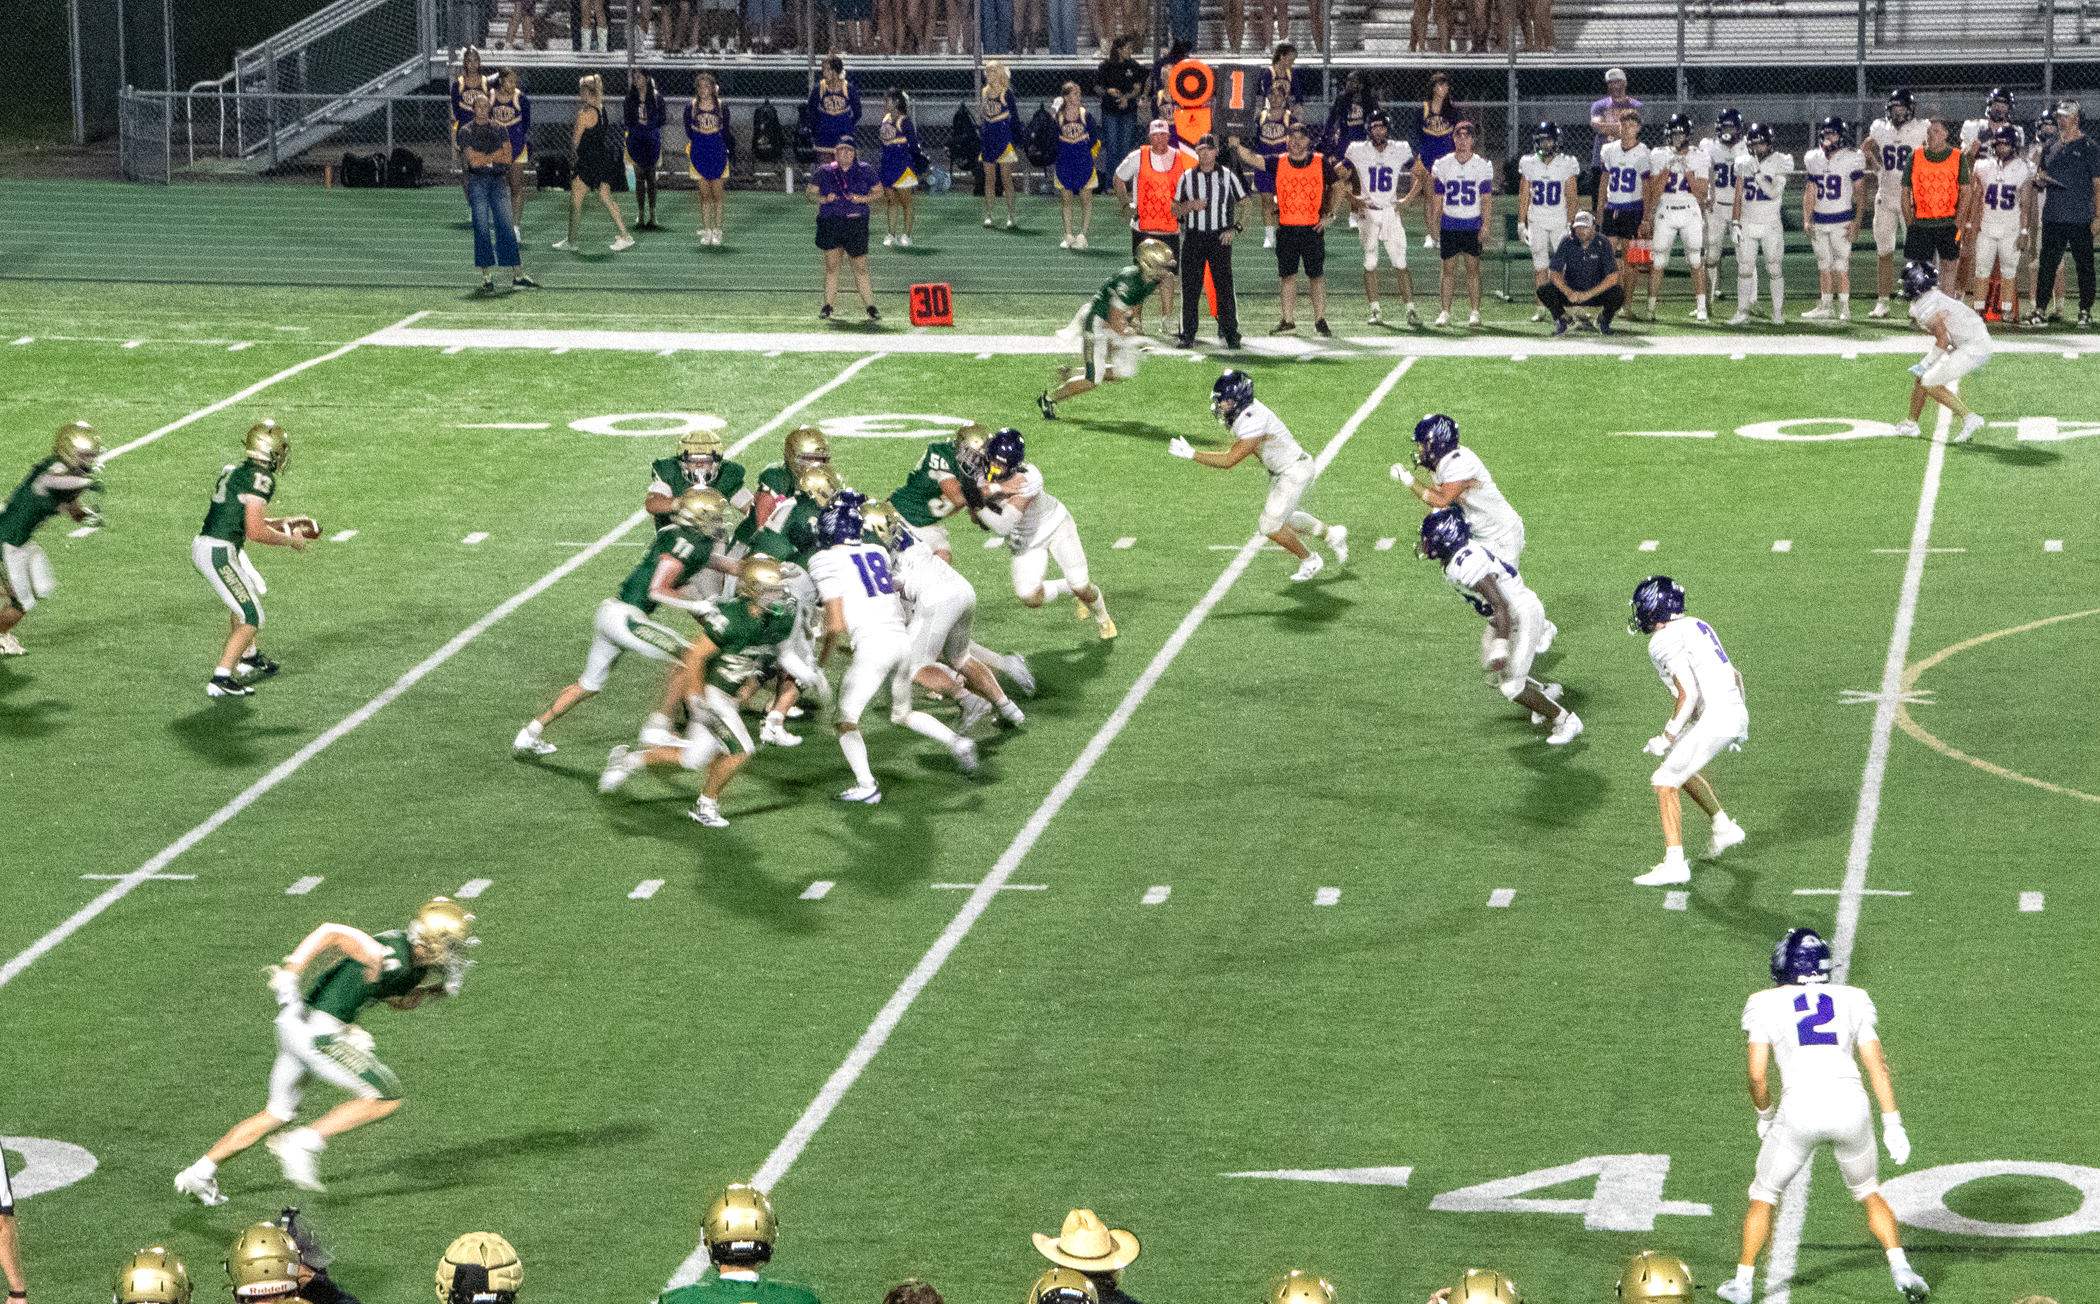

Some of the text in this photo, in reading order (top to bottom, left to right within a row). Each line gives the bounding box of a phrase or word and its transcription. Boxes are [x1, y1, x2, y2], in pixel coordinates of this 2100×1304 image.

[1229, 71, 1244, 109] 1
[1368, 166, 1393, 192] 16
[1608, 167, 1637, 193] 39
[1813, 174, 1842, 200] 59
[1445, 180, 1476, 206] 25
[1531, 180, 1562, 206] 30
[1984, 184, 2016, 210] 45
[914, 285, 949, 317] 30
[850, 551, 894, 598] 18
[1793, 992, 1839, 1047] 2
[249, 1283, 288, 1295] Riddell
